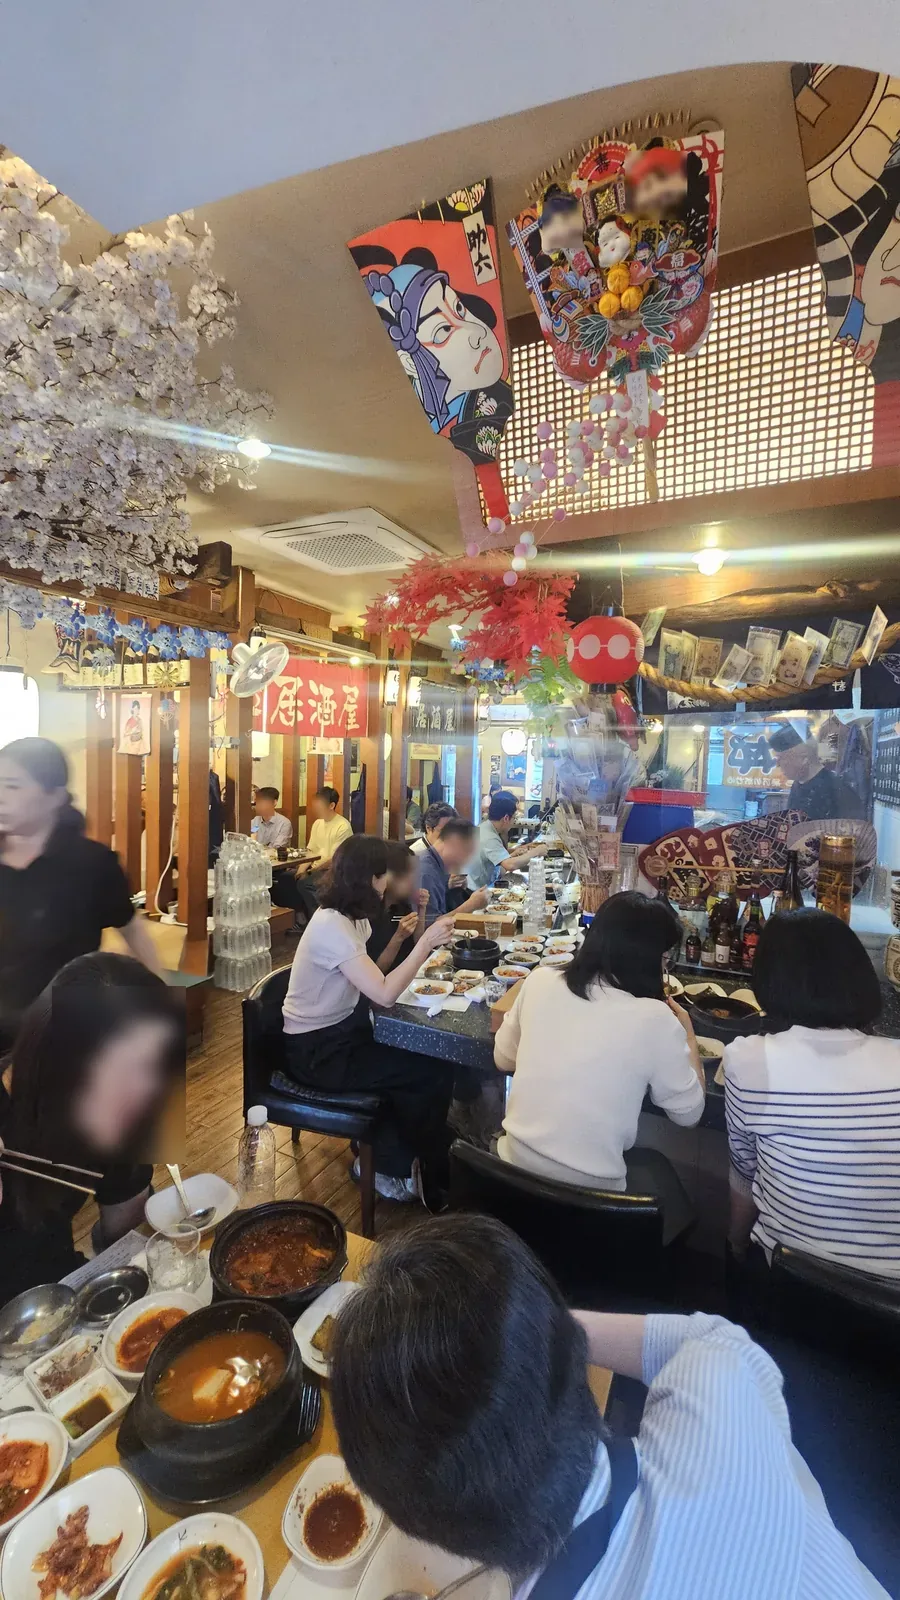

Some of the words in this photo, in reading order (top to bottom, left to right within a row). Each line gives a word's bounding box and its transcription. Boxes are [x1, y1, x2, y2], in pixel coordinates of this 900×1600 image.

[467, 223, 492, 276] 助六
[671, 252, 685, 268] 福
[270, 676, 360, 731] 居酒屋
[416, 703, 455, 731] 居酒屋
